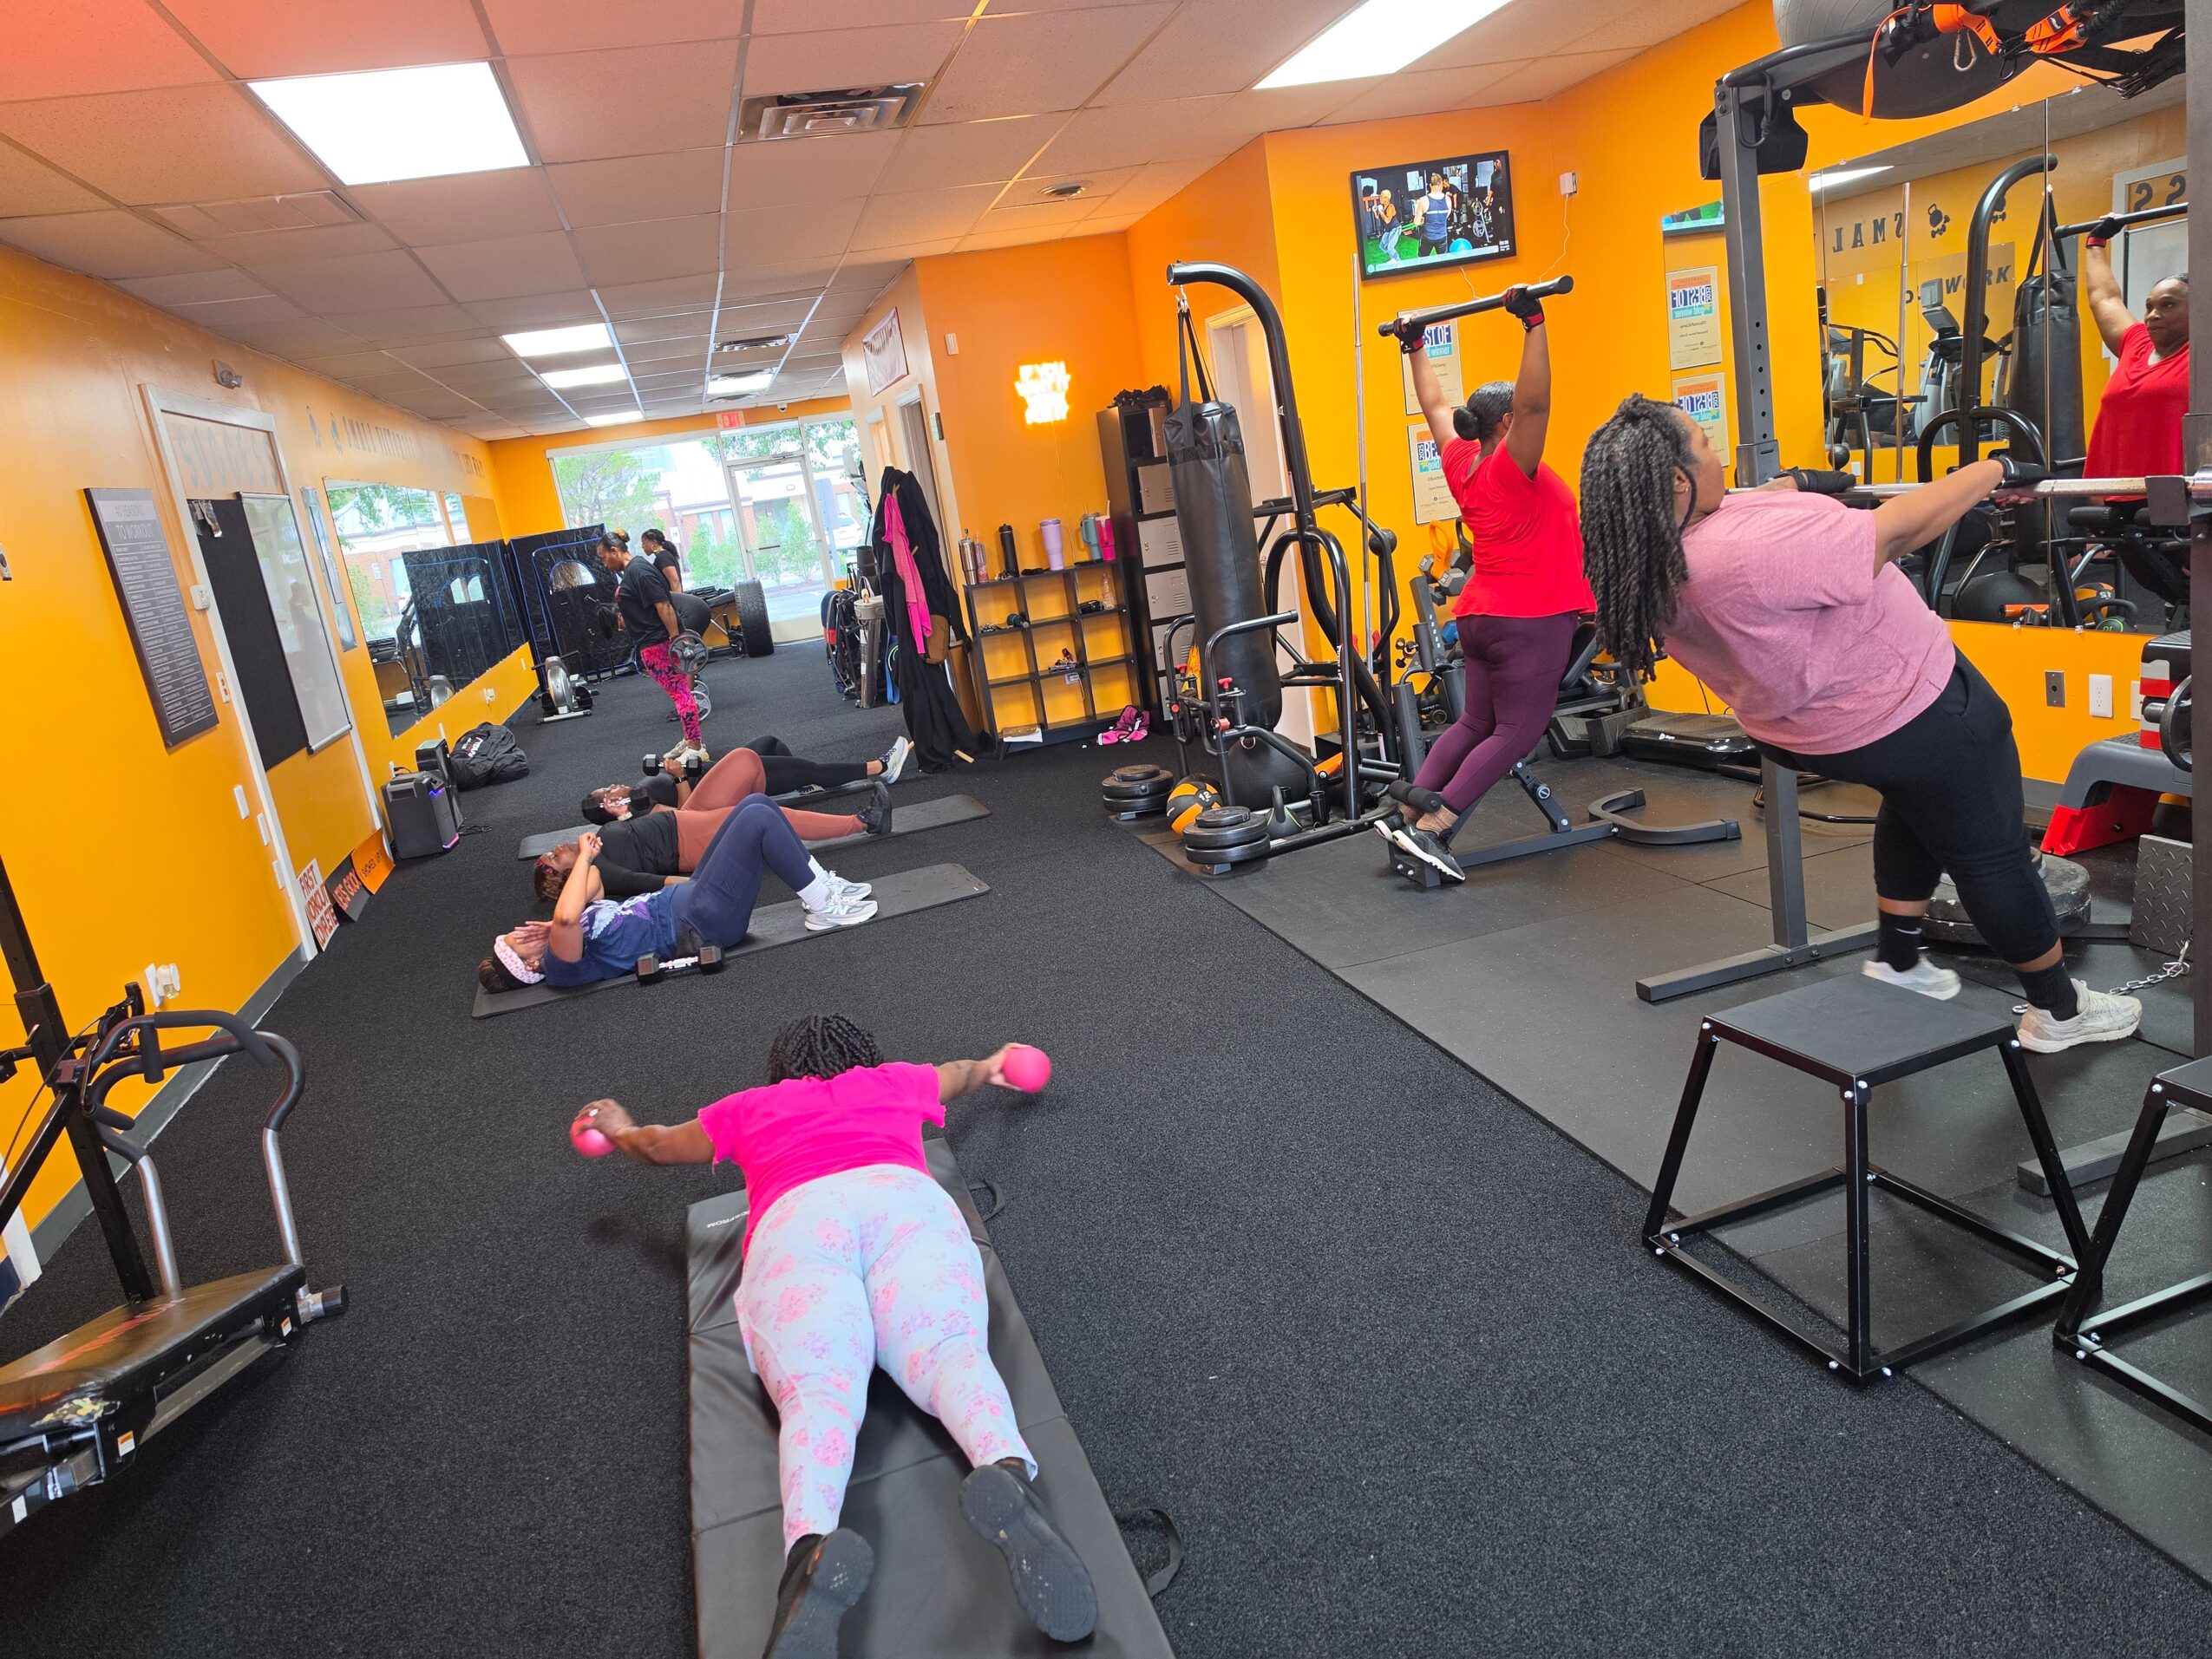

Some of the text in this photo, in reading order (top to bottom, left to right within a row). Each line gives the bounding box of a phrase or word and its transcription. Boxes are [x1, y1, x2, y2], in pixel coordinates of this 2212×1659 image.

[1437, 325, 1450, 343] OF
[1431, 346, 1450, 356] winner
[1199, 791, 1212, 801] 12
[299, 864, 318, 900] FIRST
